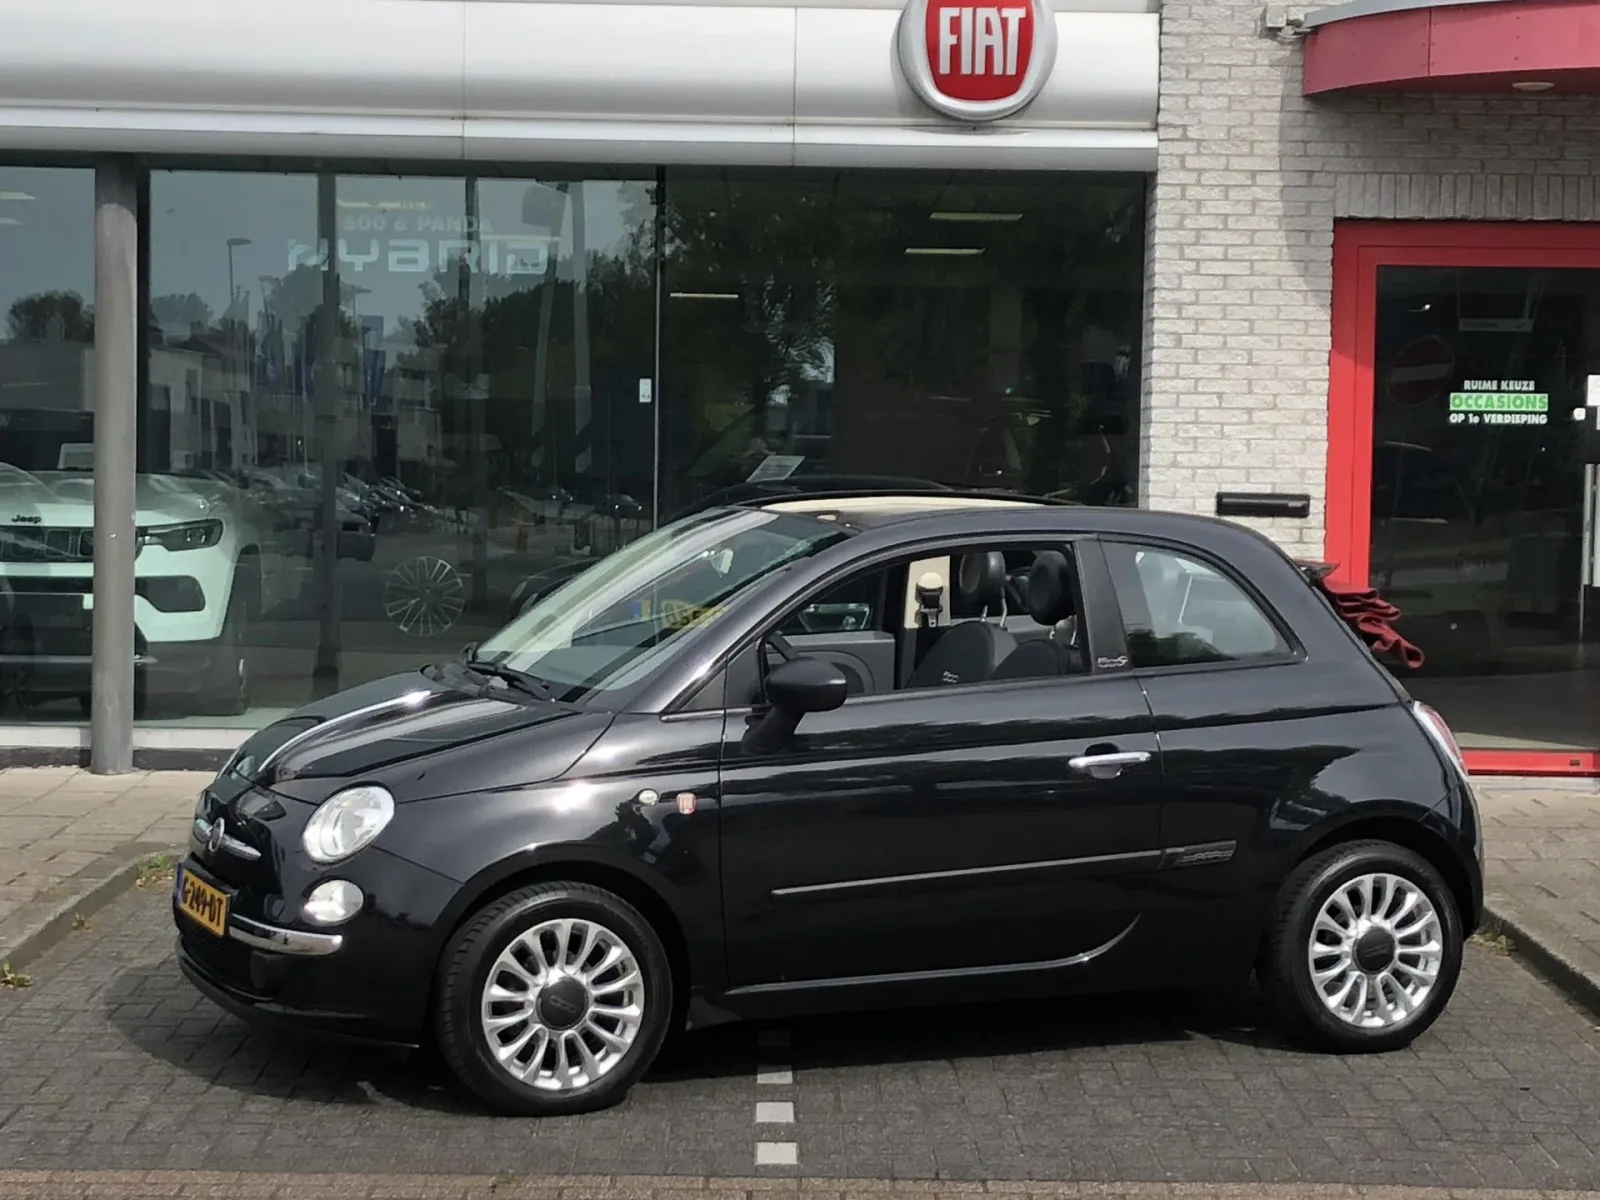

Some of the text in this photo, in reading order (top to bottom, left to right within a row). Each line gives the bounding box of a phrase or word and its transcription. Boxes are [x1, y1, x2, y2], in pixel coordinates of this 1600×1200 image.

[939, 6, 1026, 76] FIAT
[343, 214, 493, 232] 500 & PANDA
[287, 238, 549, 275] HYBRID
[1463, 380, 1535, 391] RUIME KEUZE
[1451, 394, 1547, 409] OCCASIONS
[1449, 413, 1548, 425] OP 1e VERDIEPING
[11, 514, 42, 524] Jeep
